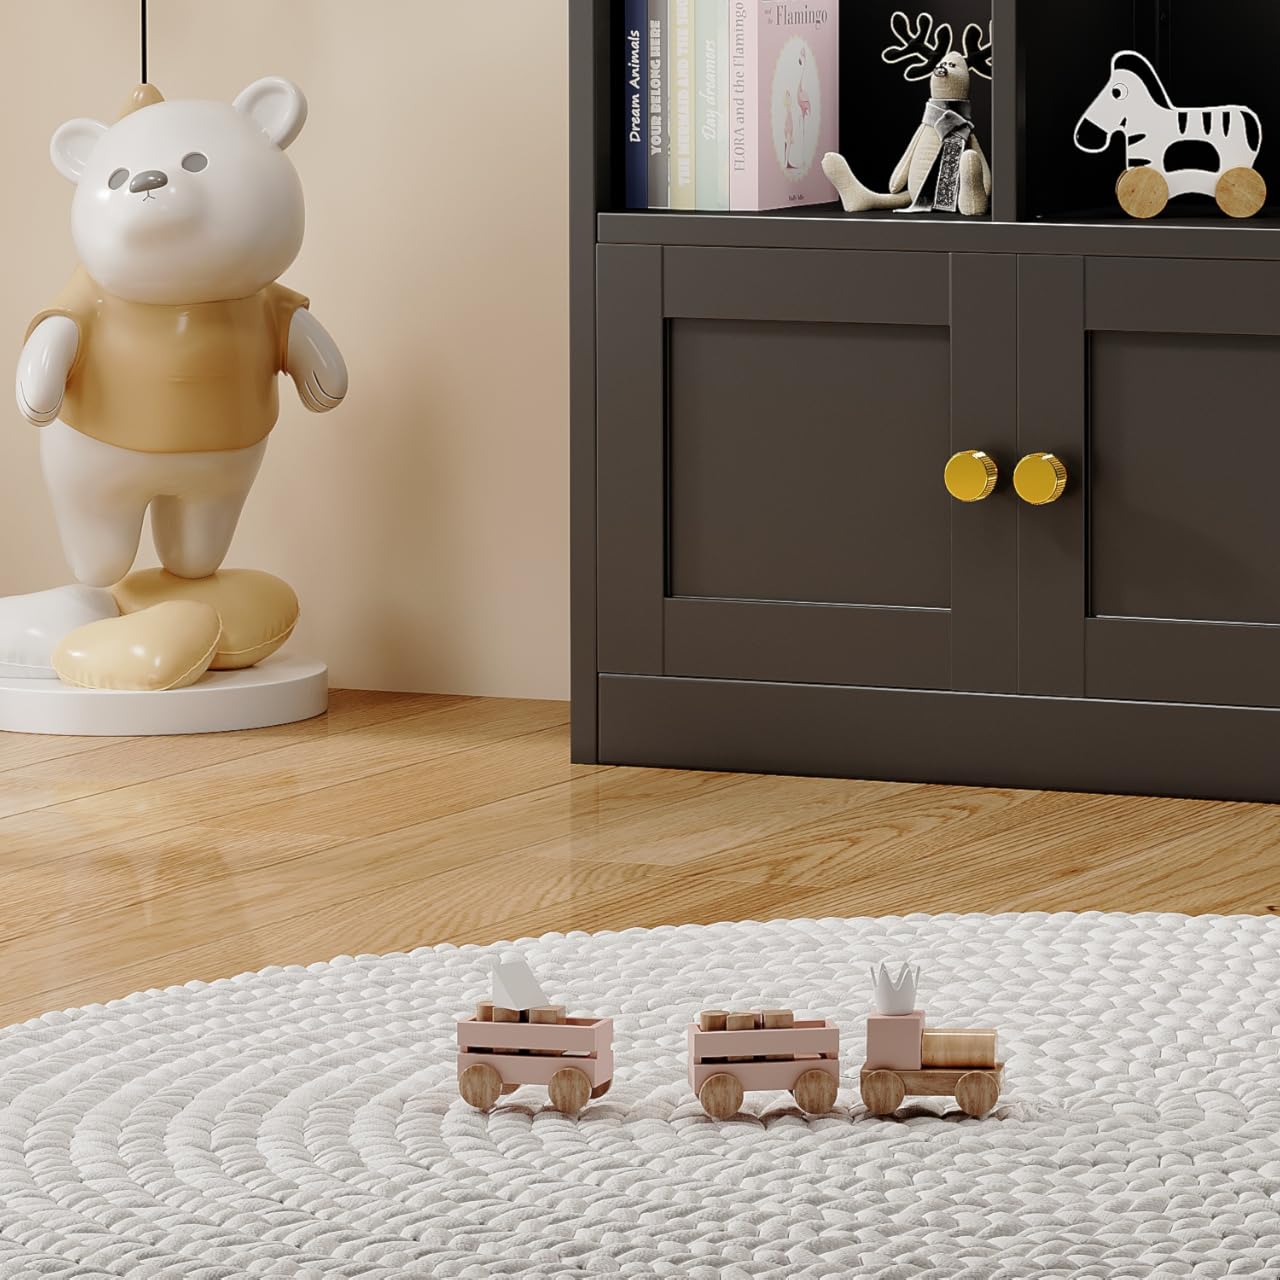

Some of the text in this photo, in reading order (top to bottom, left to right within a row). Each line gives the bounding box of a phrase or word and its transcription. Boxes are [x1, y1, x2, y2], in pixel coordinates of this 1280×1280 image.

[776, 4, 828, 30] Flamingo
[628, 29, 642, 143] Dream Animals
[650, 19, 663, 157] YOUR BELONG HERE
[699, 40, 720, 141] Day dreamers
[733, 1, 747, 172] FLORA and the Flamingo
